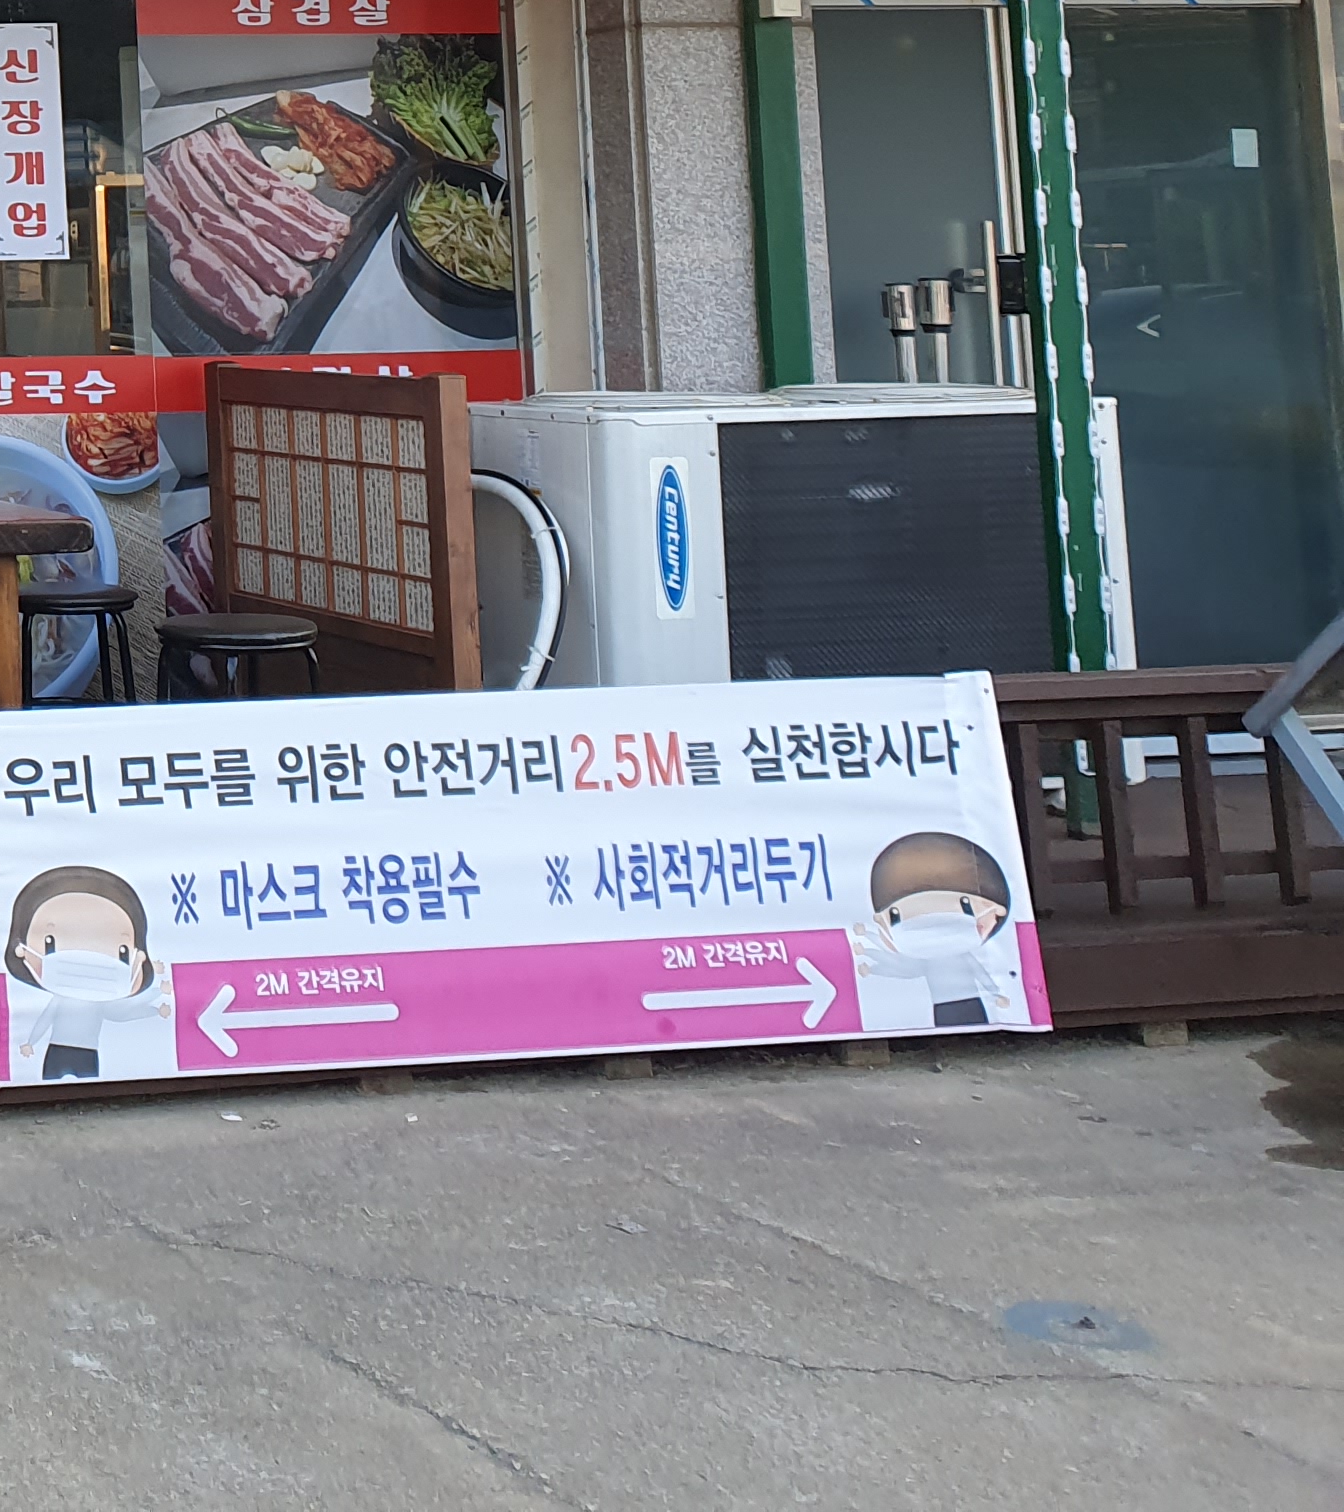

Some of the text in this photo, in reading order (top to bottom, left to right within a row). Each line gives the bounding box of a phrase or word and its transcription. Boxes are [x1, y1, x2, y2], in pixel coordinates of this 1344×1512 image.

[0, 47, 49, 239] 신장개업
[663, 485, 682, 591] Century
[3, 753, 97, 817] 우리
[117, 747, 257, 808] 모두를
[276, 742, 366, 804] 위한
[742, 718, 960, 783] 실천합시다
[219, 860, 330, 931] 마스크
[341, 850, 483, 926] 착용필수
[593, 833, 835, 913] 사회적거리두기
[254, 965, 386, 997] 2M 간격유지
[660, 938, 789, 970] 2M 간격유지
